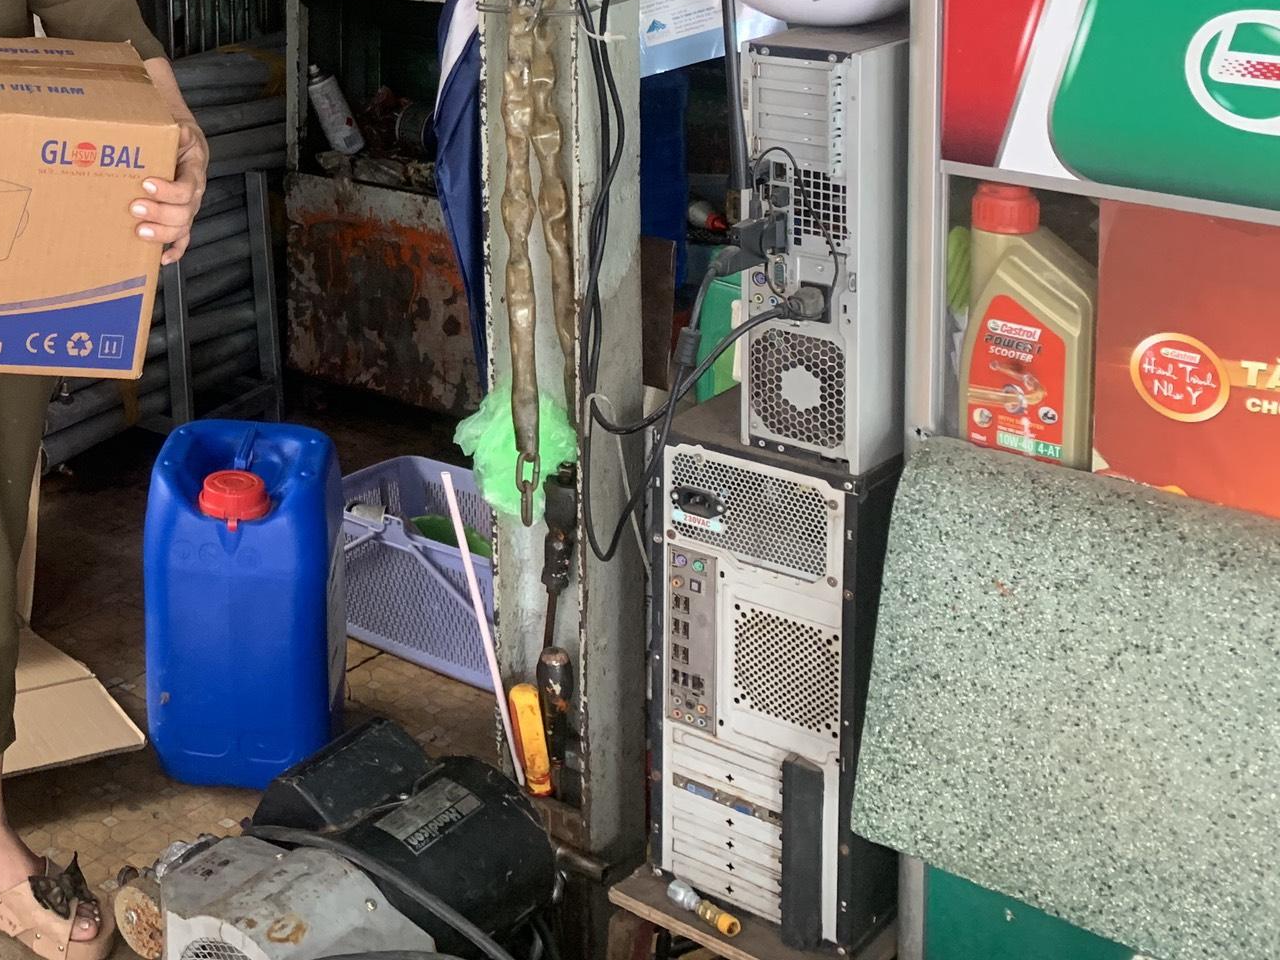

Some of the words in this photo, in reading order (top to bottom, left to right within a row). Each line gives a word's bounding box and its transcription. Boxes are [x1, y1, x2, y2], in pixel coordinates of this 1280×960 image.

[48, 86, 85, 96] NAM
[1000, 323, 1037, 339] Castrol
[987, 345, 1034, 363] SCOOTER
[1246, 397, 1280, 415] CH
[1037, 442, 1062, 459] 4-AT
[683, 514, 711, 528] 230VAC
